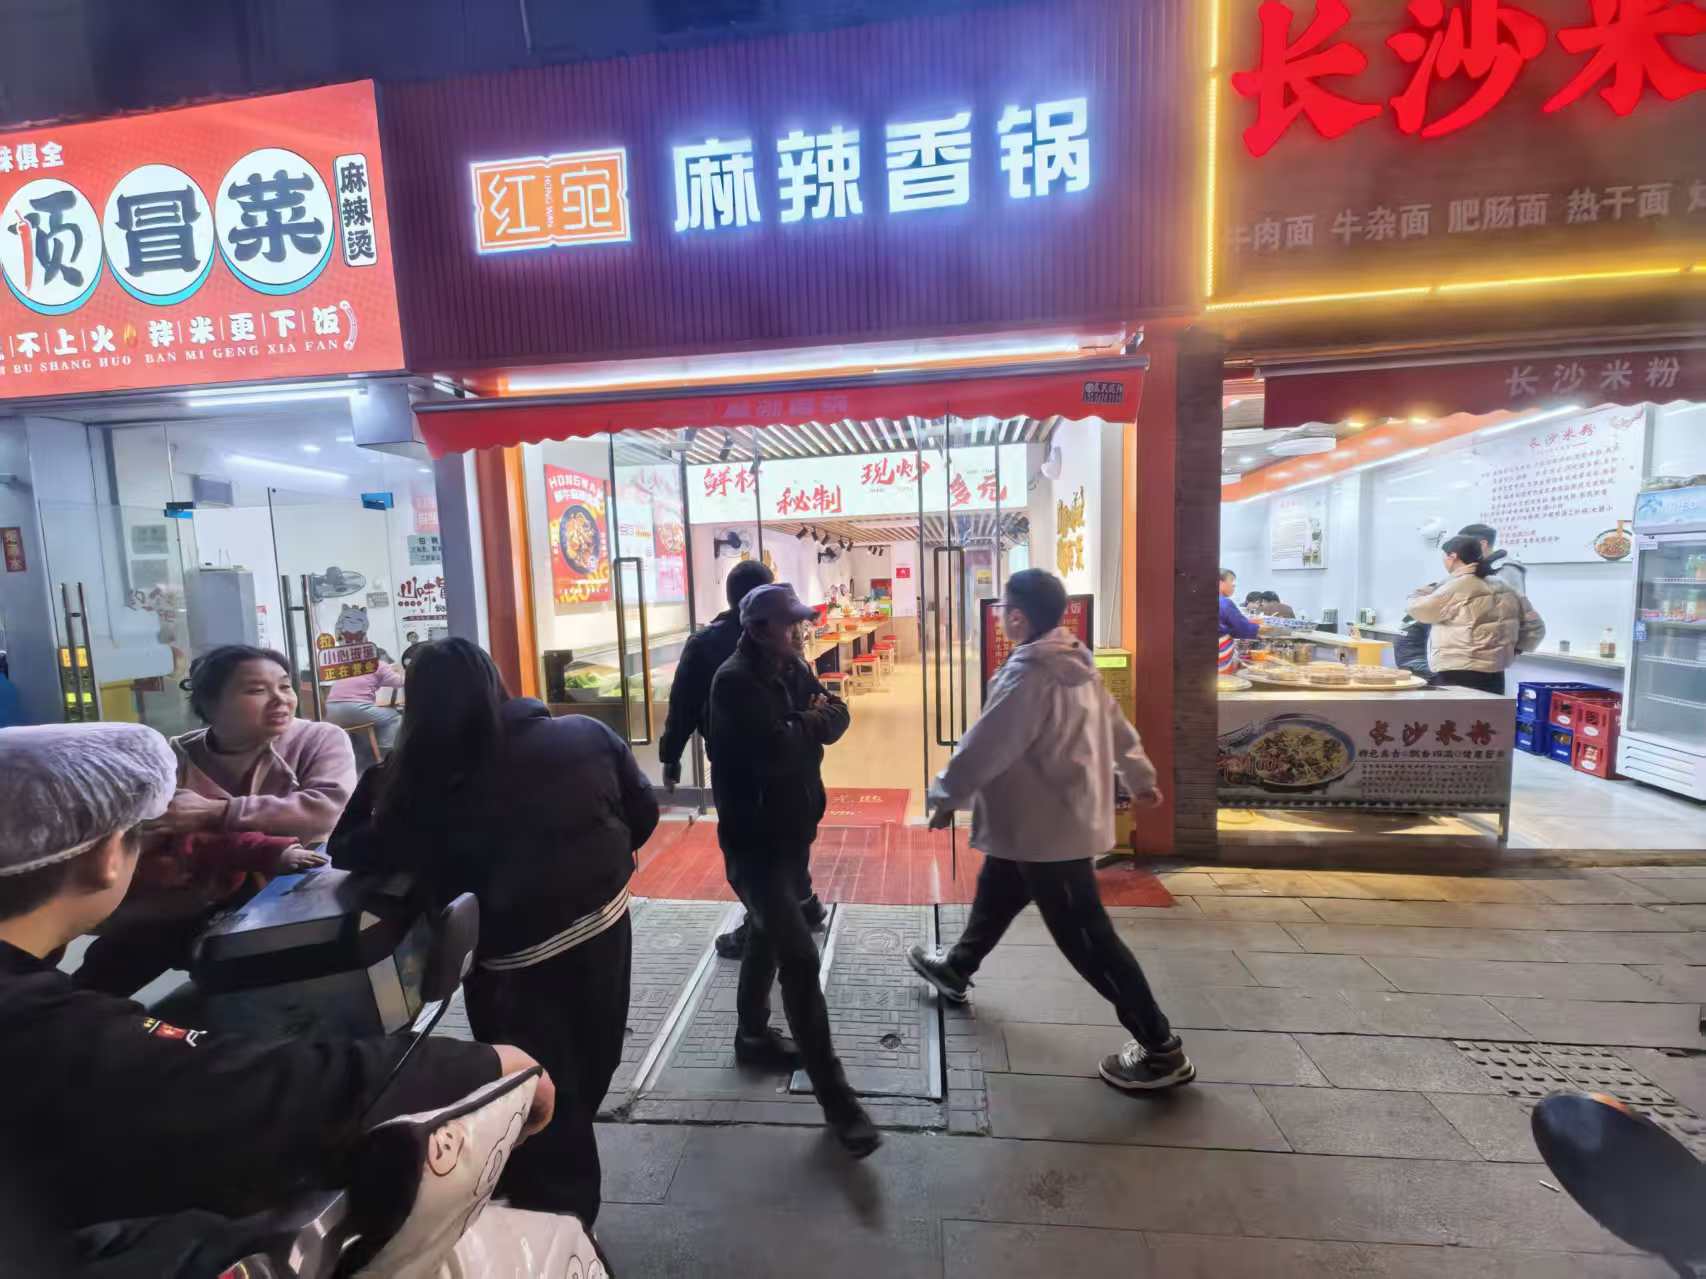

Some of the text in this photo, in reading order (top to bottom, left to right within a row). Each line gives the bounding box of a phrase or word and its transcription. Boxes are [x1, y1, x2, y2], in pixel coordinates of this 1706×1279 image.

[1232, 0, 1706, 157] 长沙米
[673, 98, 1092, 233] 麻辣香锅
[341, 162, 375, 261] 麻辣烫
[1330, 204, 1432, 245] 牛杂面
[1448, 193, 1551, 233] 肥肠面
[1567, 182, 1672, 225] 热干面
[13, 338, 338, 375] BU SHANG HUO BAN MI GENG XIA FAN
[1505, 356, 1682, 398] 长沙米粉
[860, 448, 932, 485] 现炒
[776, 483, 843, 515] 秘制
[949, 472, 1009, 507] 多元
